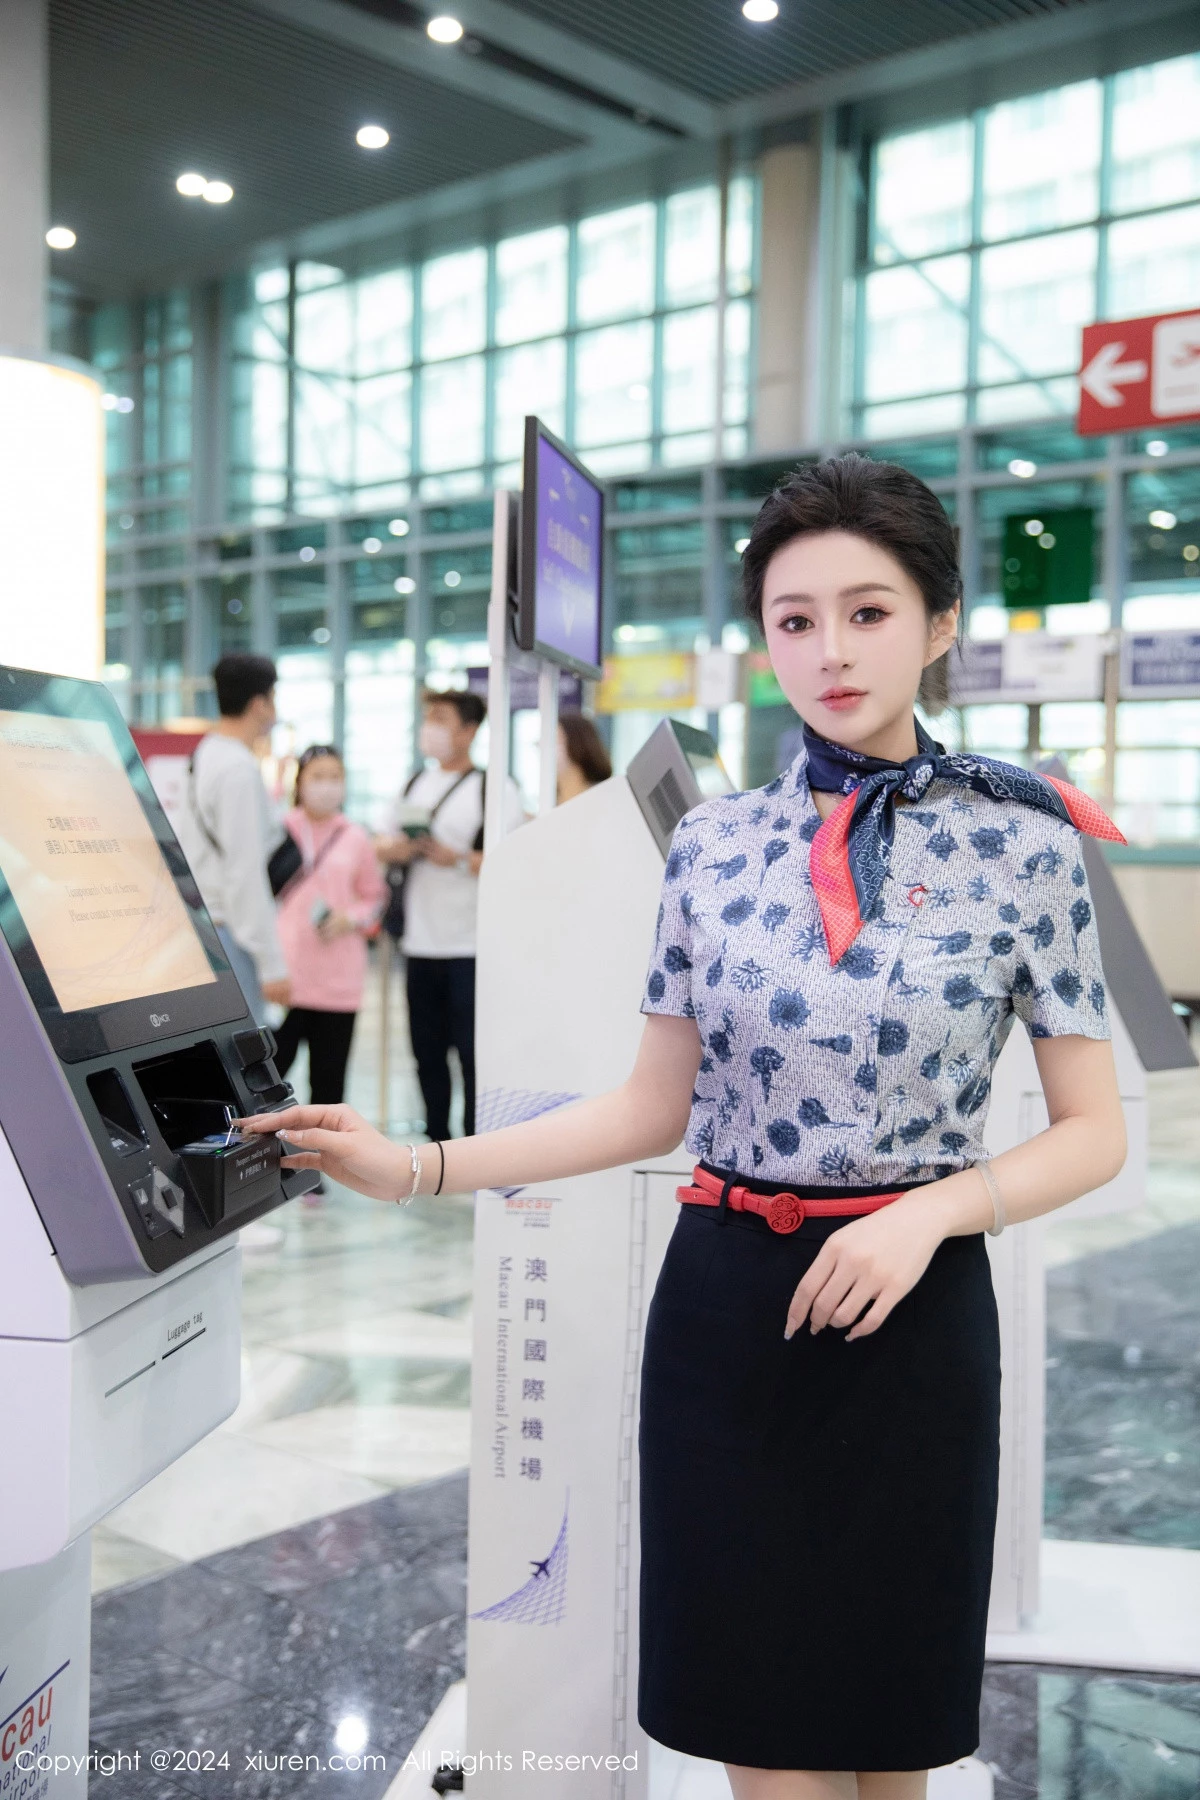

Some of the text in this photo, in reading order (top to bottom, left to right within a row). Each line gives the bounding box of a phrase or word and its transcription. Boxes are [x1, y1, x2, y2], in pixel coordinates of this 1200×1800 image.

[491, 1256, 512, 1478] Macau International Airport
[519, 1256, 547, 1480] 澳門國際機場
